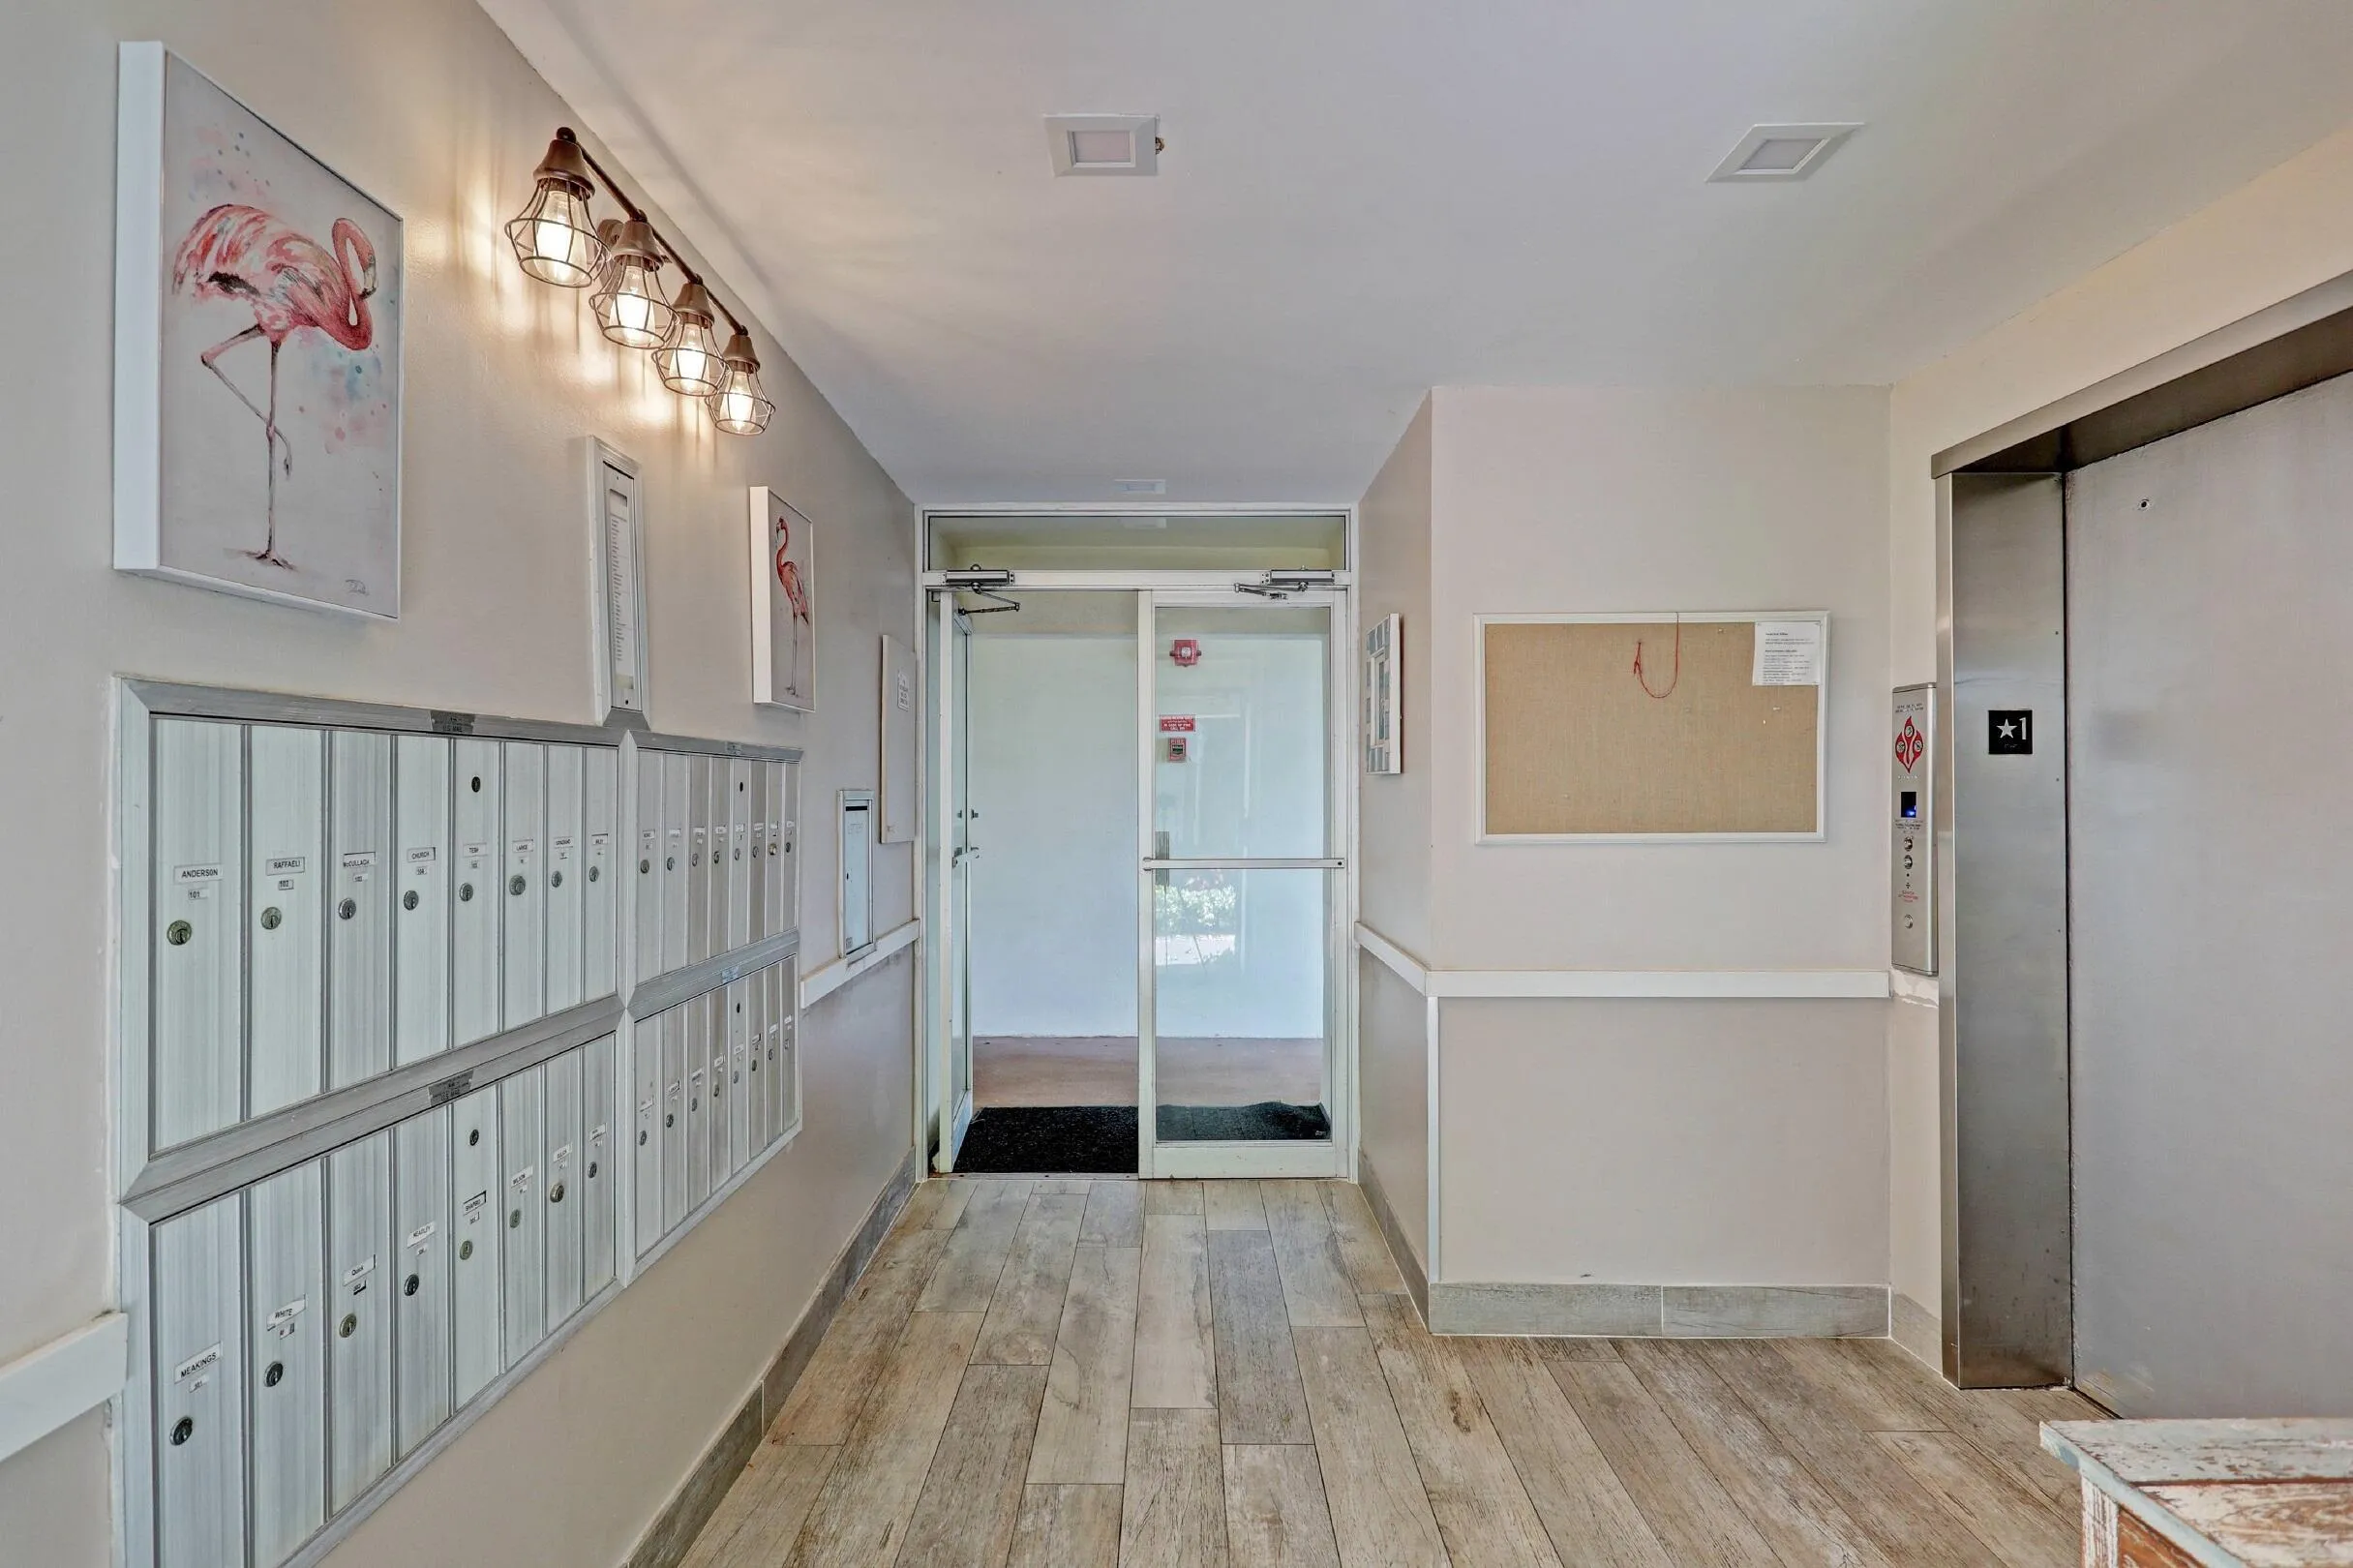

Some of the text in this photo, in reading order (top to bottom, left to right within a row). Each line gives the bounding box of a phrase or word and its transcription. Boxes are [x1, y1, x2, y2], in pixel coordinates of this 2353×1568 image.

[2018, 716, 2027, 740] 1
[273, 859, 301, 869] RAFFAELI
[181, 868, 219, 879] ANDERSON
[274, 1308, 293, 1318] WHITE
[180, 1351, 217, 1378] MEAKINGS
